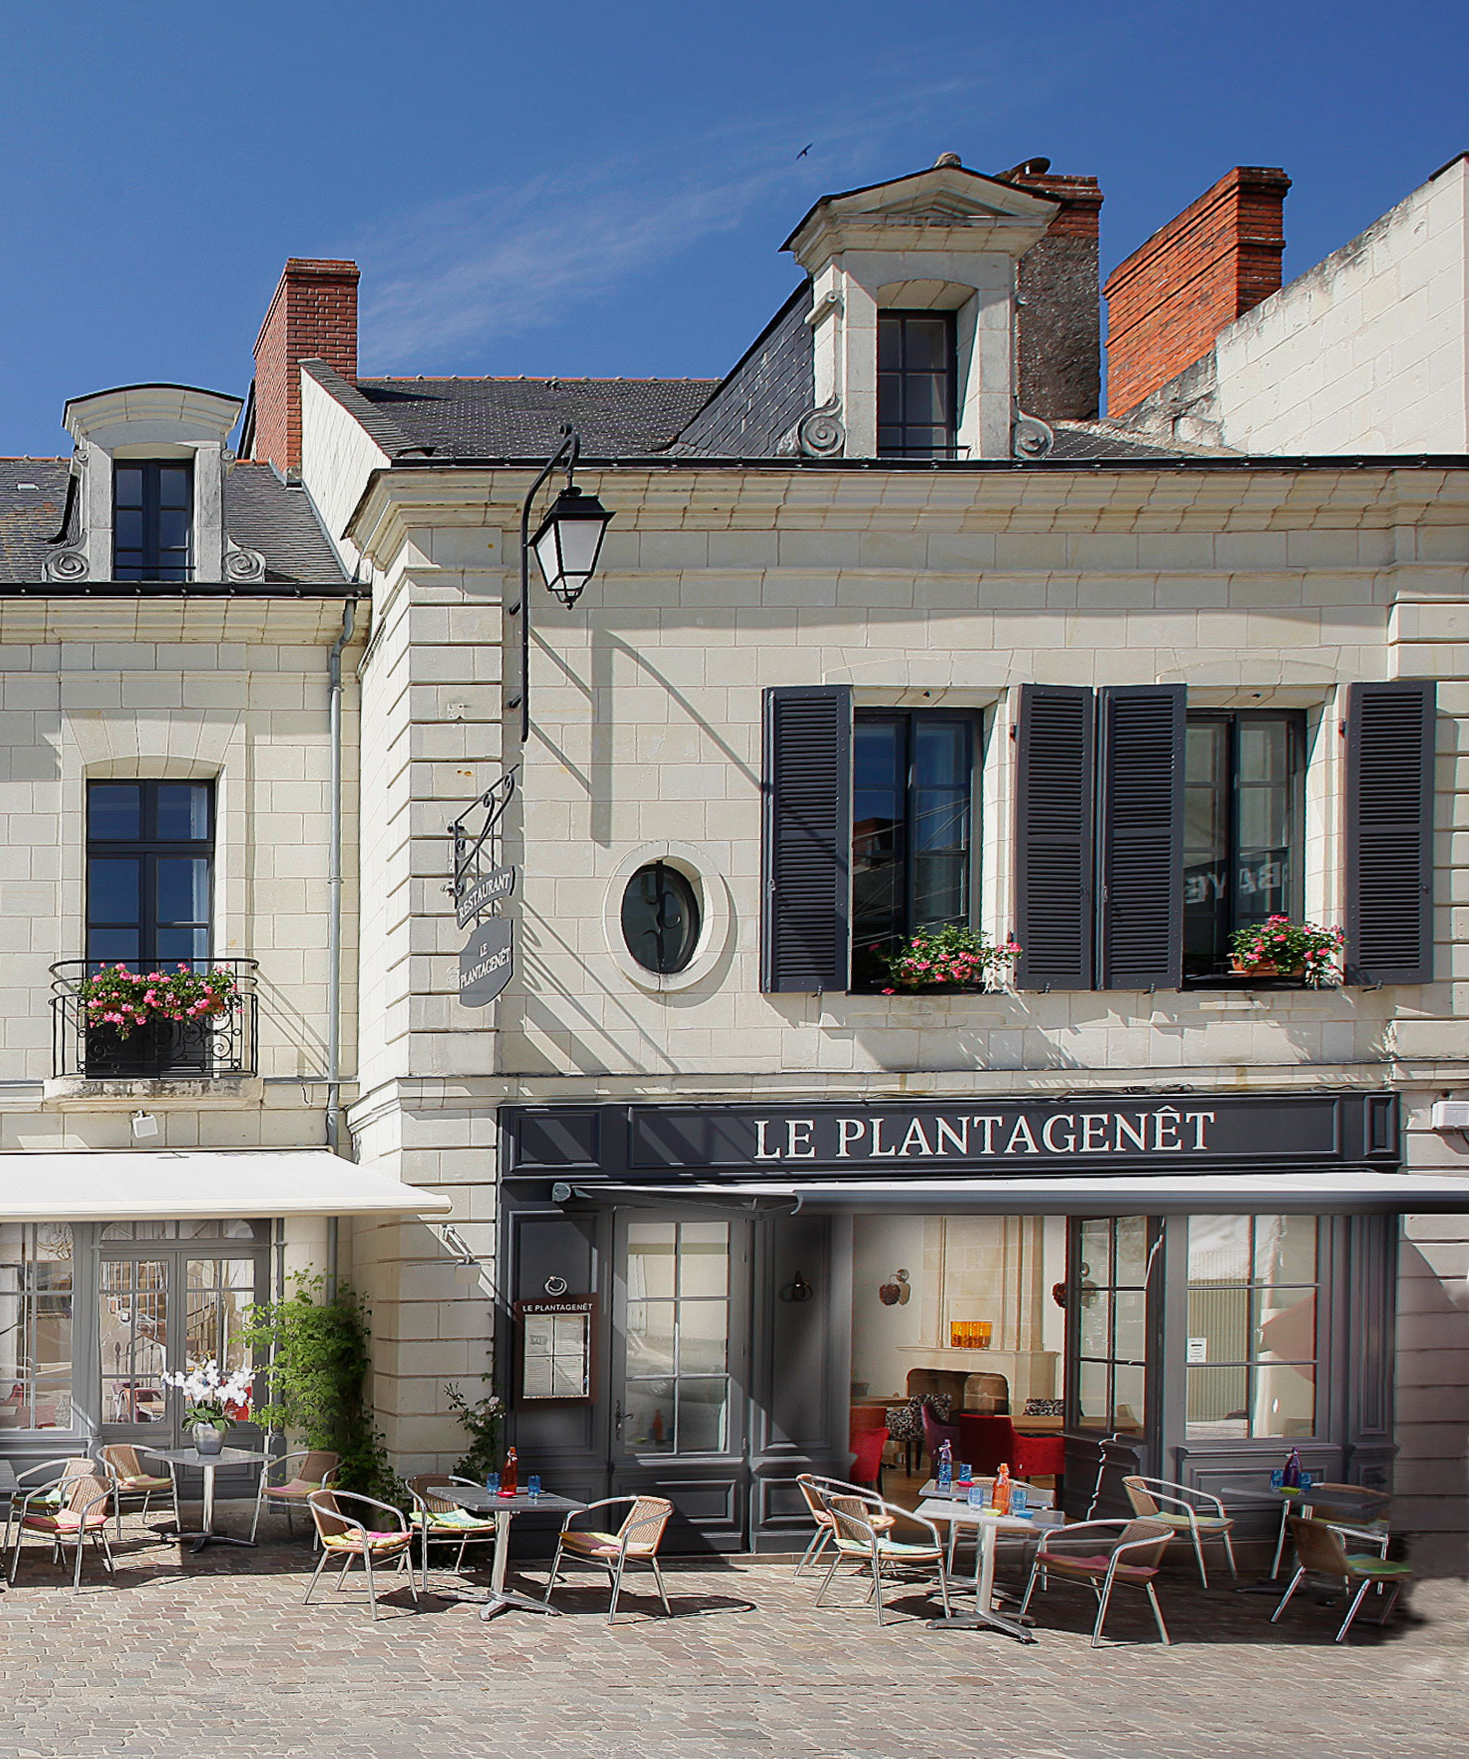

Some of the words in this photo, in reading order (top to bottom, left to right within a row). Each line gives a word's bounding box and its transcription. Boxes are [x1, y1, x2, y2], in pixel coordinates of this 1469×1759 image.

[458, 872, 511, 921] RESTAURANT
[459, 946, 512, 990] PLANTAGENÊT
[479, 942, 489, 957] LE
[753, 1119, 816, 1159] LE
[835, 1106, 1216, 1158] PLANTAGENÊT
[522, 1304, 533, 1312] LE
[535, 1302, 594, 1312] PLANTAGENÊT
